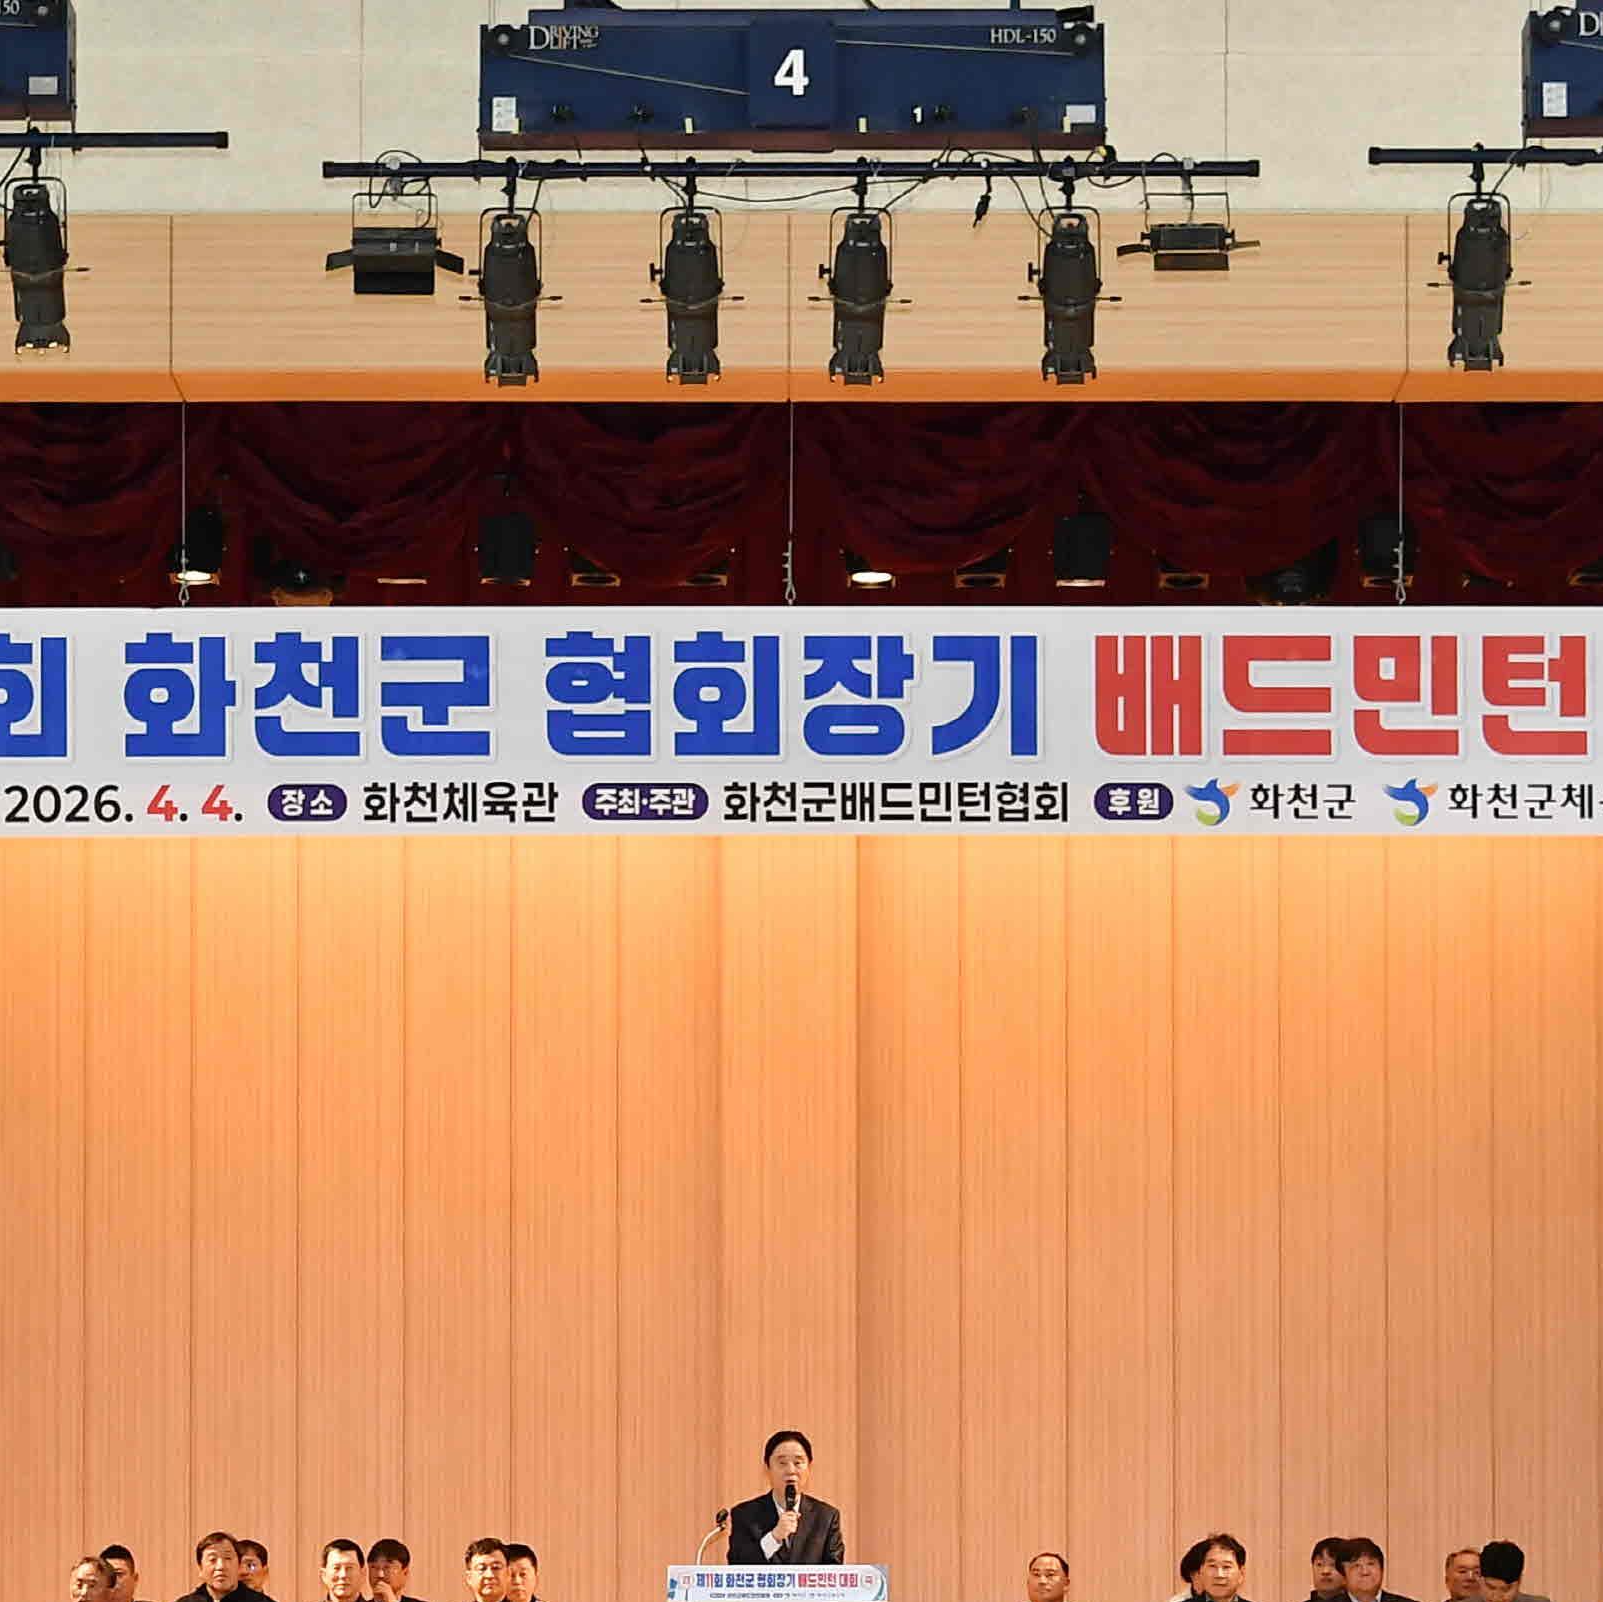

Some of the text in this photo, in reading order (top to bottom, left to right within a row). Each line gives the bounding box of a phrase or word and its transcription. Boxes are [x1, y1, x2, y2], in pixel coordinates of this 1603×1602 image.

[990, 28, 1057, 44] HDL-150
[774, 49, 809, 96] 4
[912, 106, 922, 123] 1
[124, 631, 490, 757] 화천군
[545, 630, 1038, 757] 협회장기
[1095, 634, 1588, 756] 배드민턴
[4, 785, 133, 823] 2026.
[274, 789, 334, 819] 장소
[363, 781, 559, 823] 화천체육관
[723, 781, 1068, 823] 화천군배드민턴협회
[1107, 786, 1162, 816] 후원
[1250, 783, 1356, 820] 화천군
[696, 1573, 723, 1588] 제11회
[726, 1573, 755, 1588] 화천군
[839, 1573, 858, 1588] 대회
